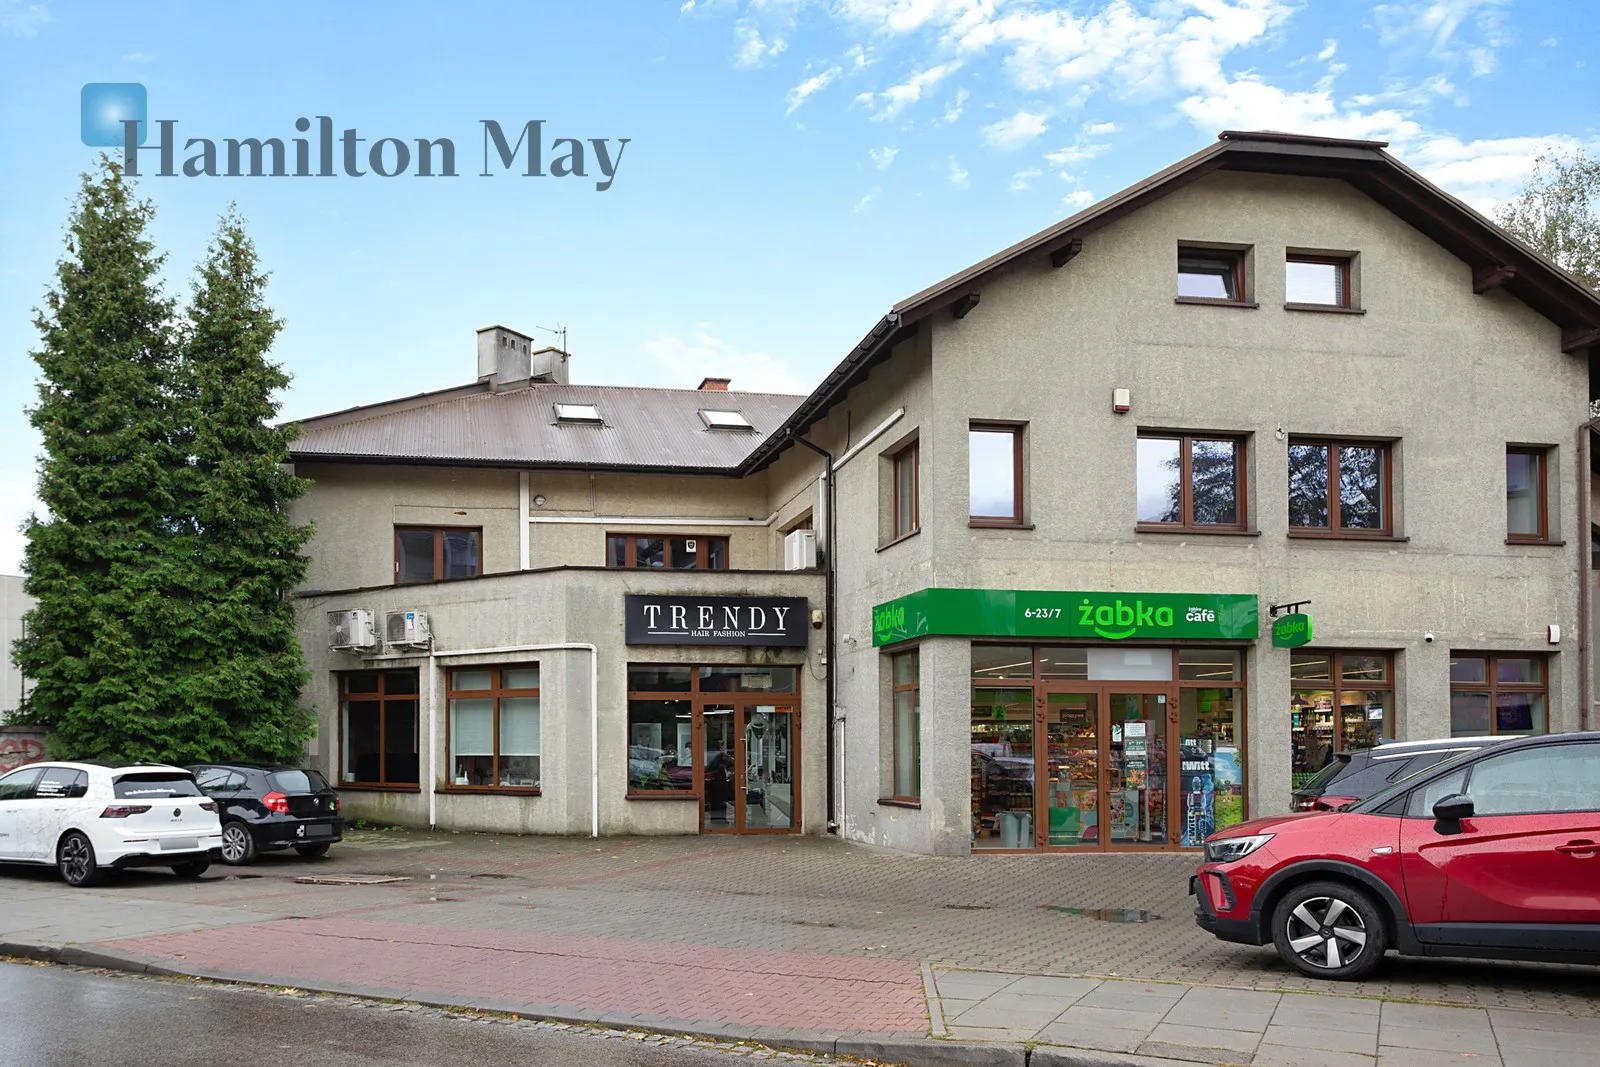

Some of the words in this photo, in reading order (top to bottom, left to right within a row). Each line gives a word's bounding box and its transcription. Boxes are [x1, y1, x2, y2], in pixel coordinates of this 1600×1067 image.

[643, 605, 790, 630] TRENDY
[874, 604, 905, 632] żabka
[1024, 608, 1061, 618] 6-23/7
[1078, 598, 1173, 627] żabka
[1276, 621, 1304, 636] żabka
